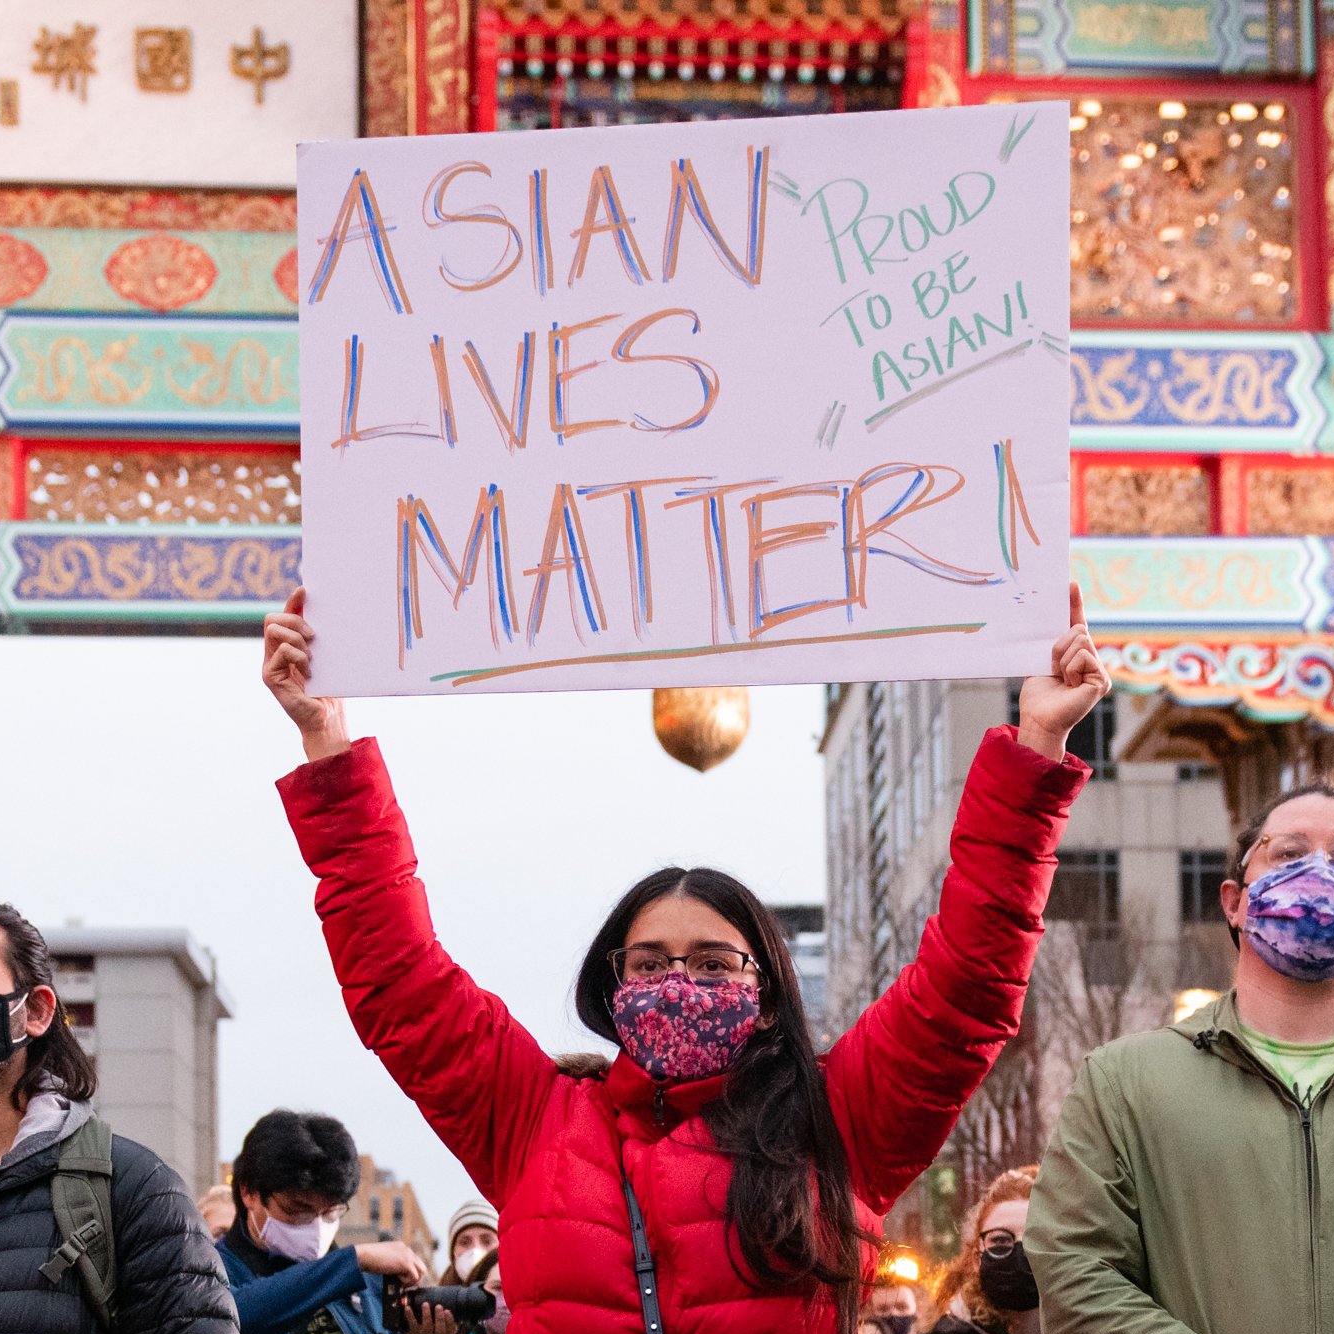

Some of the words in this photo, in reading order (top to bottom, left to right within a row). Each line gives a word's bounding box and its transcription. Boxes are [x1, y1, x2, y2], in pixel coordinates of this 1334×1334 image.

[308, 145, 771, 314] ASIAN
[800, 170, 997, 284] PROUD
[818, 289, 892, 348] TO
[911, 250, 977, 319] BE
[871, 280, 1034, 401] ASIAN!
[332, 307, 720, 456] LIVES
